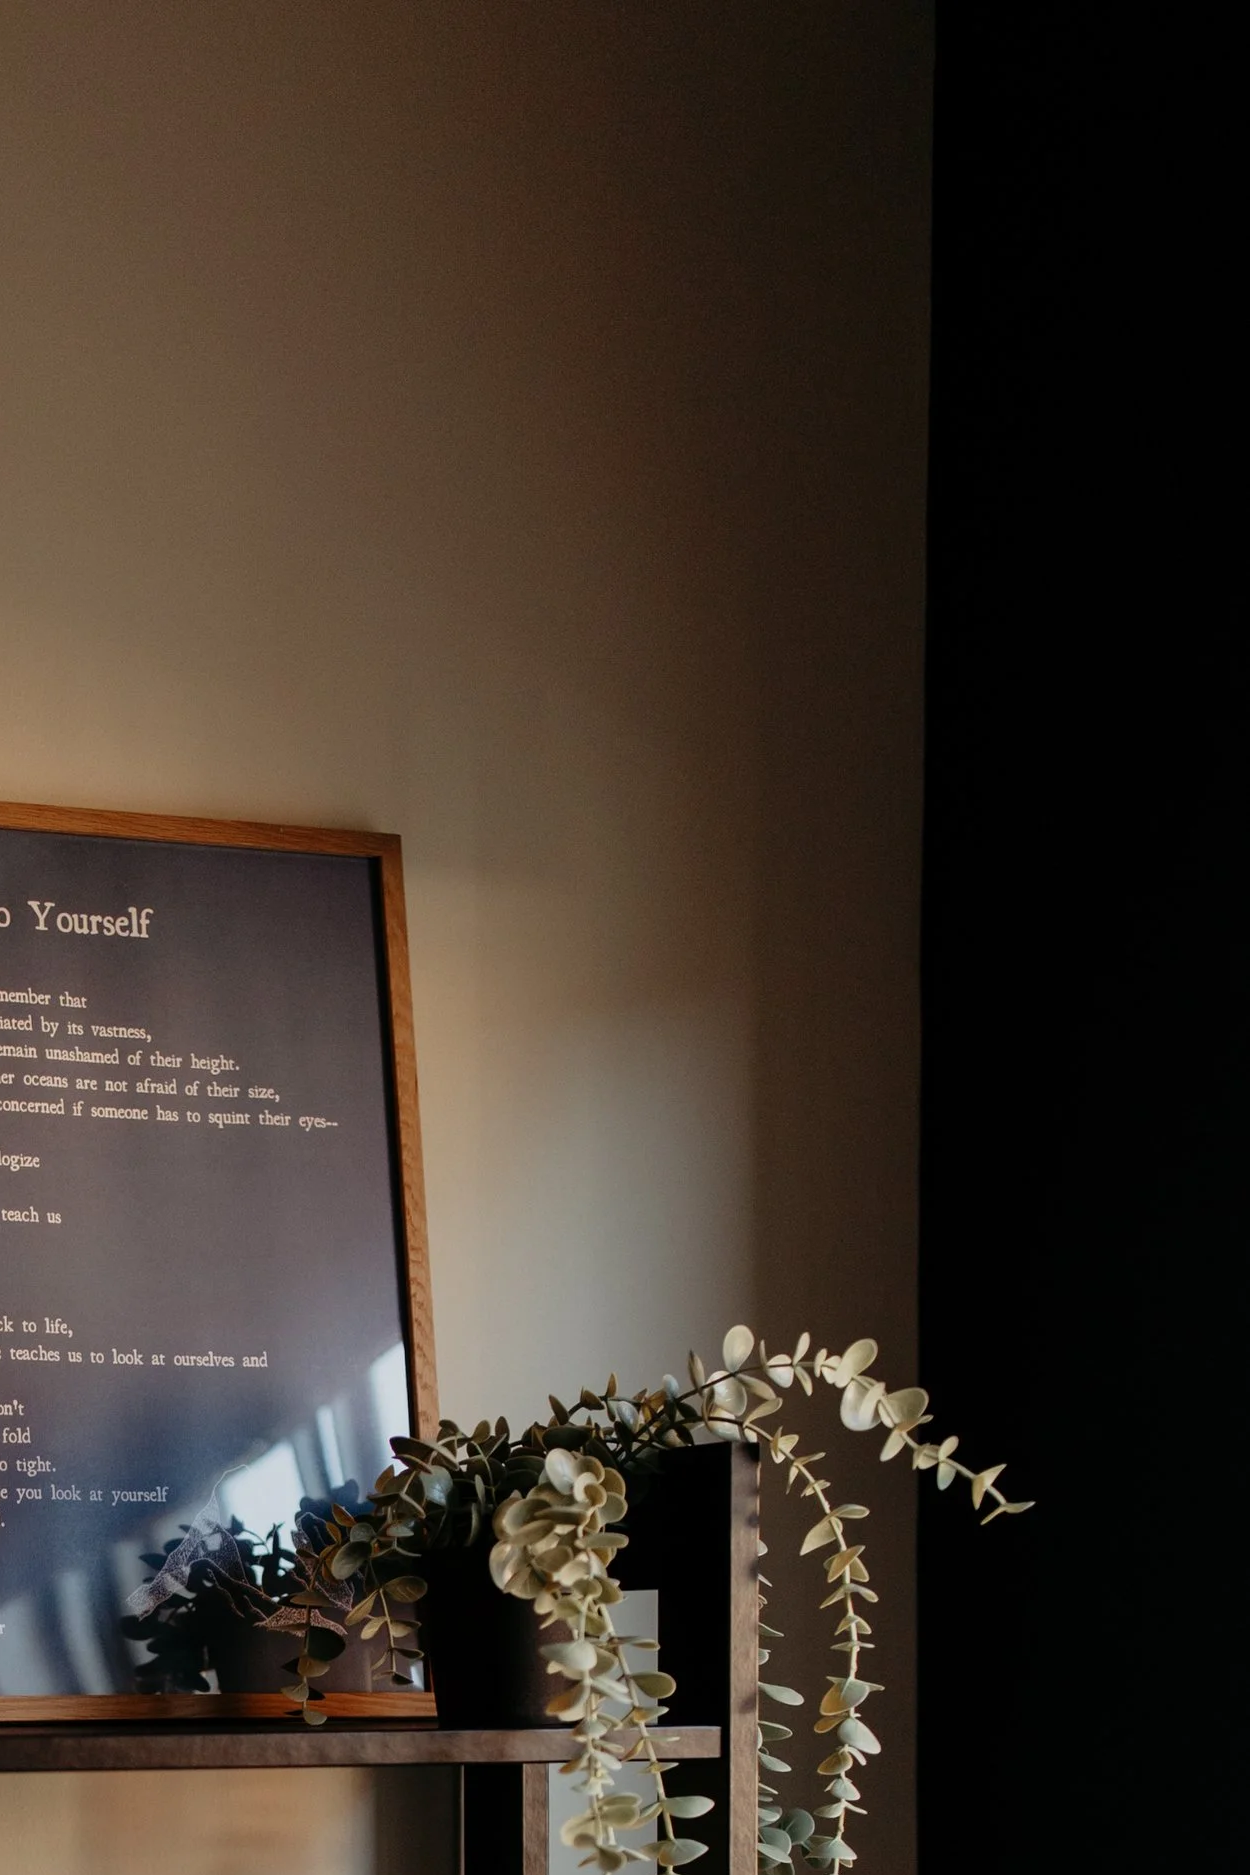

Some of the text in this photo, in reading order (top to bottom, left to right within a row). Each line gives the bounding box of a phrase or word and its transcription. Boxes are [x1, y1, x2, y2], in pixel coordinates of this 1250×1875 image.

[27, 900, 154, 938] Yourself
[59, 991, 87, 1008] that
[45, 1046, 119, 1064] unashamed
[127, 1050, 143, 1066] of
[150, 1051, 182, 1068] their
[190, 1053, 240, 1075] height.
[23, 1074, 68, 1088] oceans
[76, 1078, 97, 1090] are
[105, 1080, 128, 1092] not
[136, 1078, 177, 1095] afraid
[185, 1080, 200, 1096] of
[207, 1081, 240, 1097] their
[248, 1085, 280, 1102] size,
